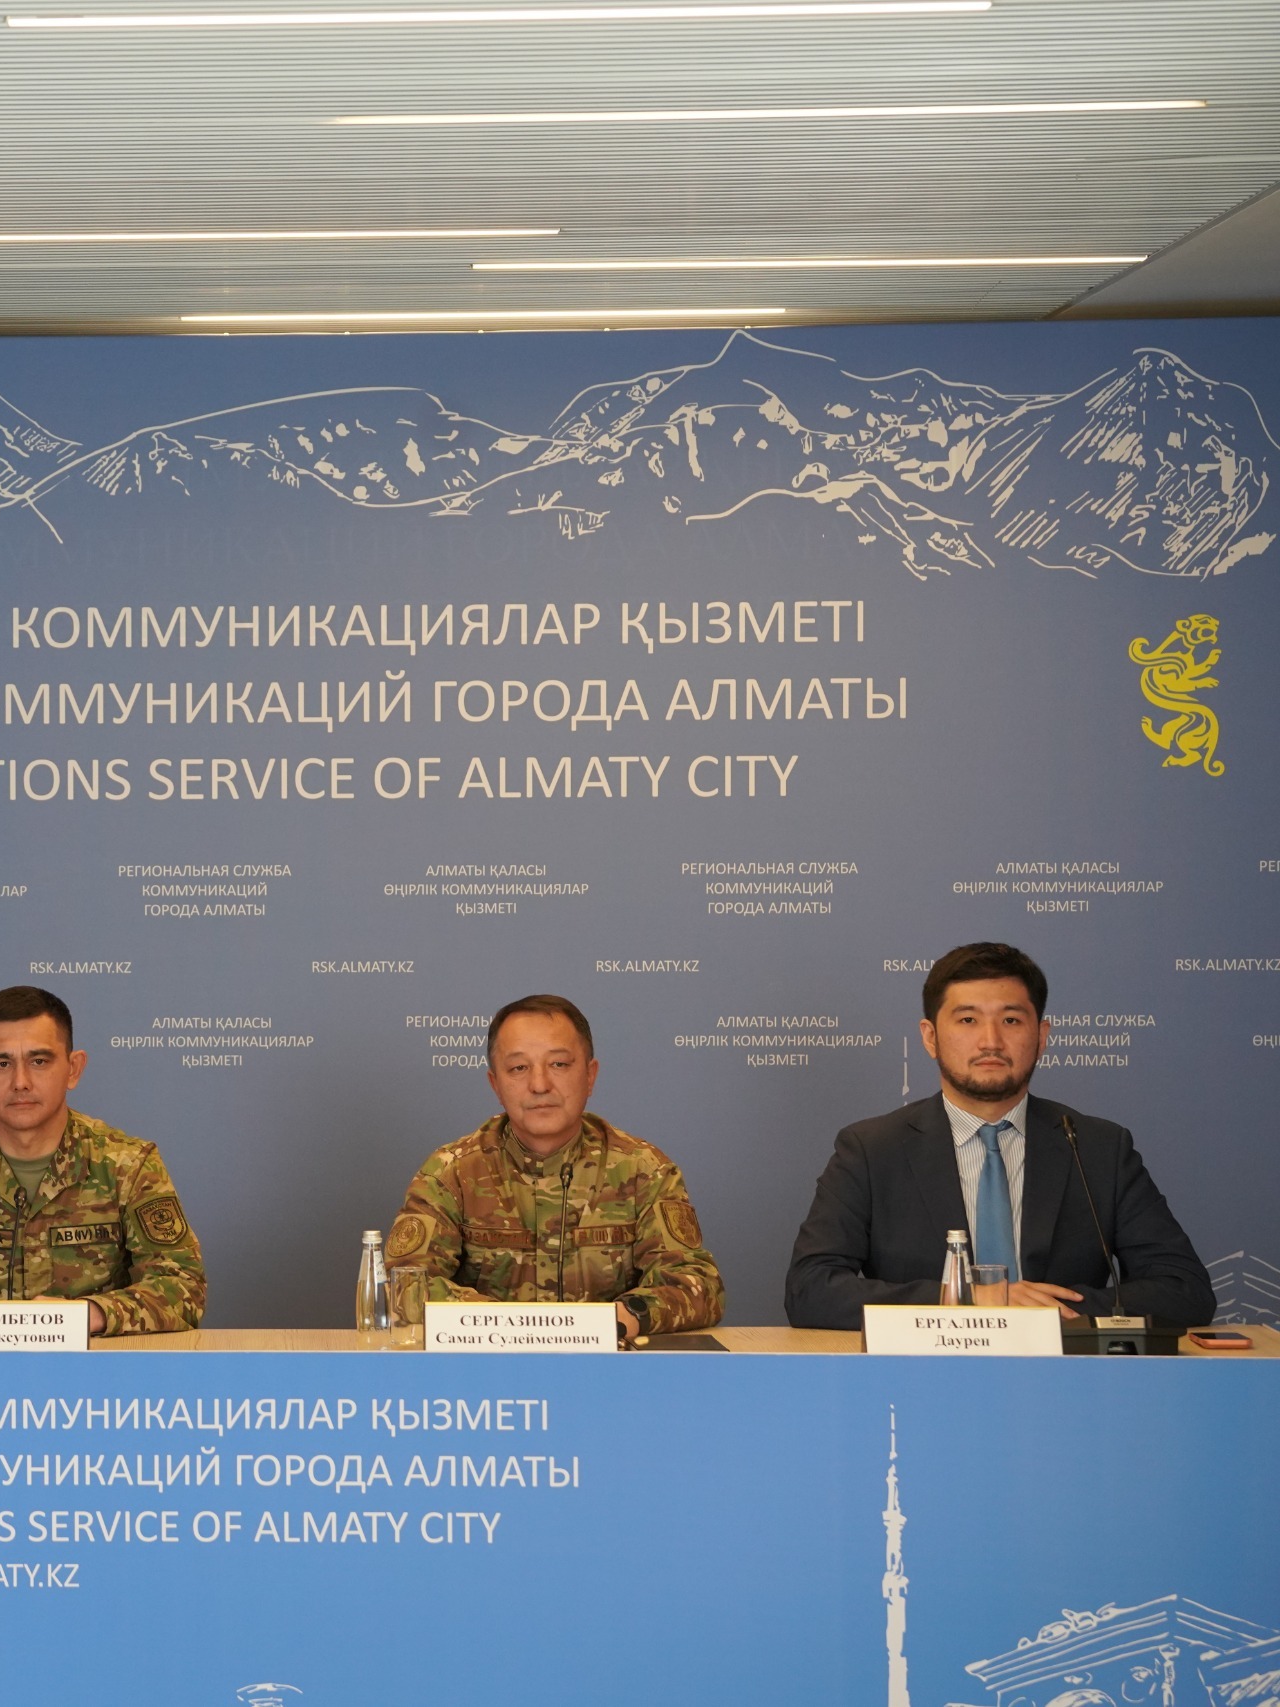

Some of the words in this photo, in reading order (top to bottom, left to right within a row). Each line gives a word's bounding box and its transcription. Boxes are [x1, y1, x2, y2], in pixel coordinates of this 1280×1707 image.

[12, 603, 601, 657] КОММУНИКАЦИЯЛАР
[621, 600, 864, 655] ҚЫЗМЕТІ
[434, 679, 650, 732] ГОРОДА
[665, 677, 907, 721] АЛМАТЫ
[148, 757, 355, 801] SERVICE
[374, 756, 442, 800] OF
[458, 755, 671, 799] ALMATY
[687, 754, 799, 798] CITY
[118, 864, 229, 878] РЕГИОНАЛЬНАЯ
[232, 864, 292, 877] СЛУЖБА
[425, 864, 486, 877] АЛМАТЫ
[489, 864, 546, 879] ҚАЛАСЫ
[681, 862, 795, 875] РЕГИОНАЛЬНАЯ
[798, 861, 859, 875] СЛУЖБА
[995, 862, 1057, 875] АЛМАТЫ
[1061, 861, 1120, 877] ҚАЛАСЫ
[142, 881, 268, 899] КОММУНИКАЦИЙ
[383, 883, 438, 898] ӨҢІРЛІК
[441, 883, 589, 898] КОММУНИКАЦИЯЛАР
[705, 879, 834, 897] КОММУНИКАЦИЙ
[952, 881, 1008, 896] ӨҢІРЛІК
[1012, 880, 1164, 896] КОММУНИКАЦИЯЛАР
[144, 903, 201, 919] ГОРОДА
[203, 903, 266, 916] АЛМАТЫ
[455, 902, 517, 917] ҚЫЗМЕТІ
[708, 901, 765, 917] ГОРОДА
[768, 901, 832, 915] АЛМАТЫ
[1026, 900, 1089, 915] ҚЫЗМЕТІ
[30, 961, 132, 974] RSK.ALMATY.KZ
[311, 960, 415, 974] RSK.ALMATY.KZ
[596, 959, 700, 973] RSK.ALMATY.KZ
[1175, 958, 1280, 972] RSK.ALMATY.KZ
[151, 1017, 212, 1029] АЛМАТЫ
[215, 1016, 272, 1032] ҚАЛАСЫ
[406, 1015, 493, 1028] РЕГИОНАЛЬ
[716, 1015, 777, 1028] АЛМАТЫ
[781, 1015, 839, 1030] ҚАЛАСЫ
[1095, 1014, 1156, 1027] СЛУЖБА
[110, 1036, 164, 1050] ӨҢІРЛІК
[168, 1035, 314, 1050] КОММУНИКАЦИЯЛАР
[674, 1035, 729, 1049] ӨҢІРЛІК
[732, 1034, 882, 1049] КОММУНИКАЦИЯЛАР
[1046, 1032, 1131, 1048] УНИКАЦИЙ
[182, 1054, 243, 1069] ҚЫЗМЕТІ
[432, 1054, 488, 1069] ГОРОДА
[747, 1053, 809, 1068] ҚЫЗМЕТІ
[1064, 1054, 1129, 1067] АЛМАТЫ
[460, 1314, 575, 1327] СЕРГАЗИНОВ
[914, 1317, 1008, 1329] ЕРГАЛИЕВ
[435, 1332, 484, 1345] Самат
[487, 1332, 600, 1348] Сулейменович
[935, 1334, 991, 1350] Даурен
[371, 1398, 548, 1438] ҚЫЗМЕТІ
[236, 1454, 393, 1495] ГОРОДА
[403, 1454, 579, 1488] АЛМАТЫ
[28, 1510, 180, 1543] SERVICE
[192, 1510, 242, 1543] OF
[253, 1510, 409, 1544] ALMATY
[420, 1511, 502, 1544] CITY
